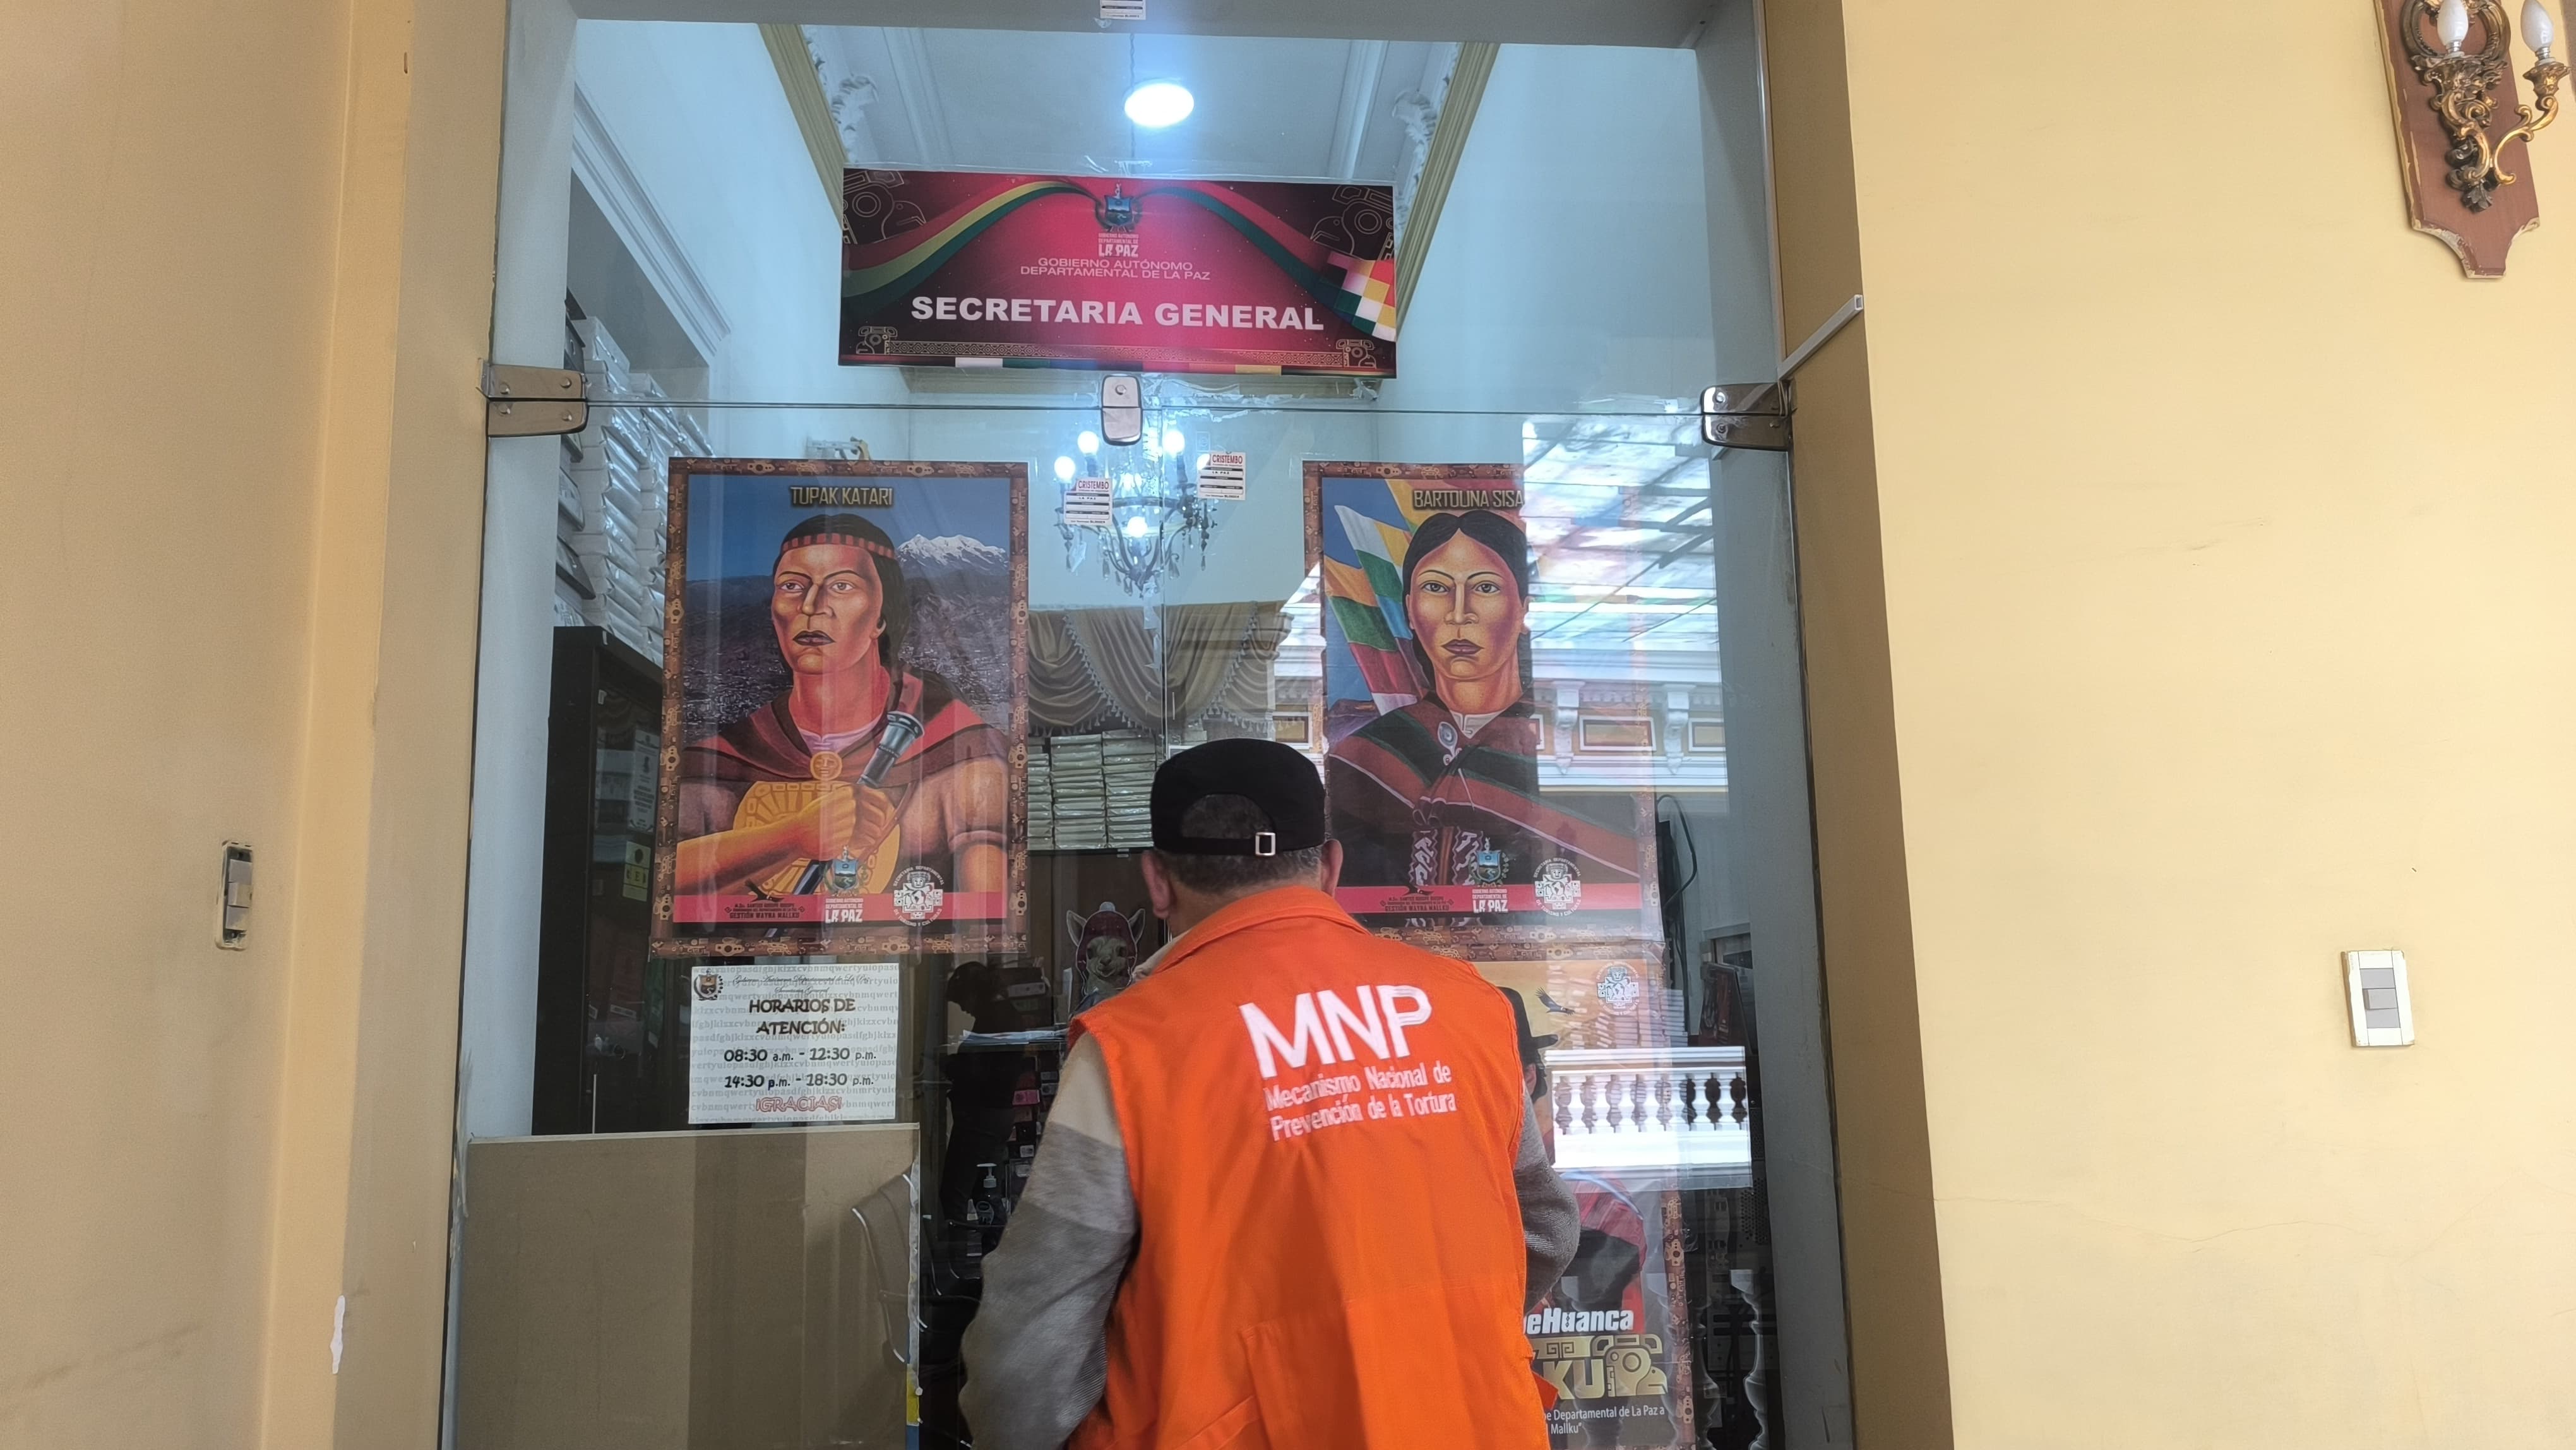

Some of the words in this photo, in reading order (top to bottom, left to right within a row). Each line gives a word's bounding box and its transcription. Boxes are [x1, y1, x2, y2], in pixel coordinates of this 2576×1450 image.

[1099, 243, 1112, 257] LA
[1115, 244, 1138, 258] PAZ
[1038, 258, 1109, 268] GOBIERNO
[1114, 258, 1193, 271] AUTÓNOMO
[1021, 267, 1138, 279] DEPARTAMENTAL
[1142, 270, 1160, 279] DE
[1164, 270, 1181, 280] LA
[1184, 272, 1210, 280] PAZ
[911, 296, 1142, 325] SECRETARIA
[1155, 303, 1324, 330] GENERAL
[1212, 455, 1243, 464] CRISTEMBO
[1078, 481, 1109, 489] CRISTEMBO
[790, 487, 838, 505] TUPAK
[842, 488, 893, 505] KATARI
[1473, 900, 1486, 913] LA
[1488, 900, 1508, 913] PAZ
[825, 909, 839, 923] LA
[841, 909, 863, 923] PAZ
[749, 998, 830, 1014] HORARIOS
[834, 998, 856, 1012] DE
[756, 1017, 845, 1036] ATENCIÓN:
[1239, 985, 1432, 1079] MNP
[724, 1049, 768, 1062] 08:30
[773, 1053, 794, 1062] a.m.
[809, 1047, 850, 1061] 12:30
[856, 1051, 876, 1061] p.m.
[724, 1075, 765, 1088] 14:30
[768, 1079, 790, 1091] p.m.
[806, 1073, 847, 1086] 18:30
[852, 1076, 874, 1086] p.m.
[1263, 1073, 1361, 1111] Mecanismo
[1364, 1062, 1428, 1091] Nacional
[1433, 1060, 1452, 1084] de
[1270, 1094, 1364, 1142] Prevención
[1368, 1095, 1386, 1120] de
[1388, 1093, 1403, 1118] la
[1404, 1091, 1457, 1117] Tortura
[1524, 1308, 1634, 1334] eHuanca
[1554, 1406, 1616, 1422] Departamental
[1619, 1406, 1630, 1417] de
[1632, 1406, 1641, 1417] La
[1643, 1405, 1658, 1416] Paz
[1660, 1406, 1664, 1415] a
